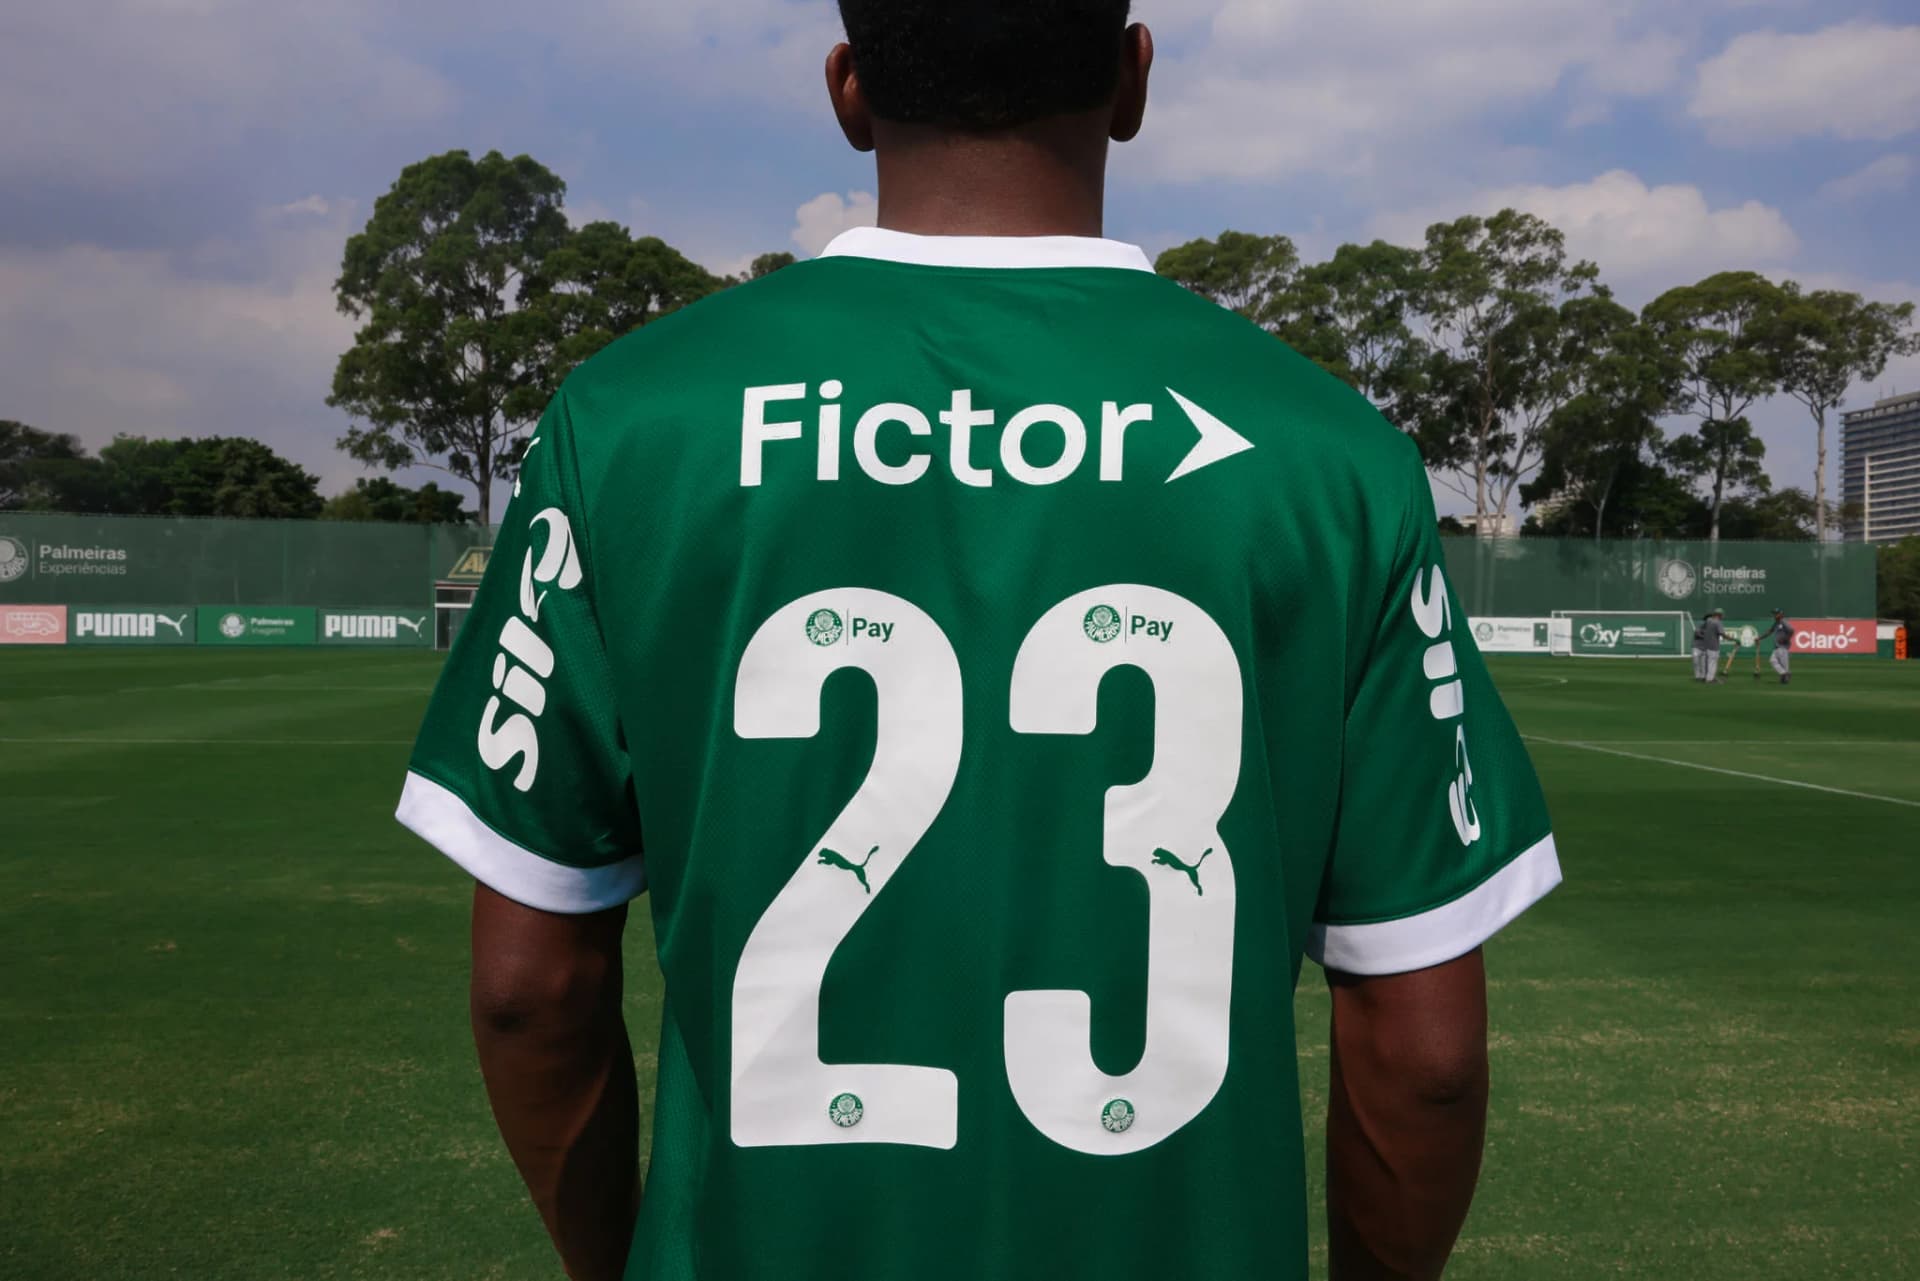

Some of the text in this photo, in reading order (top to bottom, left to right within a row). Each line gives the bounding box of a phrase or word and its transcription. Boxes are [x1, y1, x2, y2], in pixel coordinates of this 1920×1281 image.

[740, 379, 1152, 487] Fictor
[39, 544, 127, 560] Palmeiras
[39, 562, 127, 576] Experiências
[1703, 565, 1766, 579] Palmeiras
[77, 613, 155, 637] PUMA
[325, 615, 397, 638] PUMA
[852, 618, 894, 643] Pay
[1131, 615, 1173, 642] Pay
[1795, 631, 1848, 649] Claro
